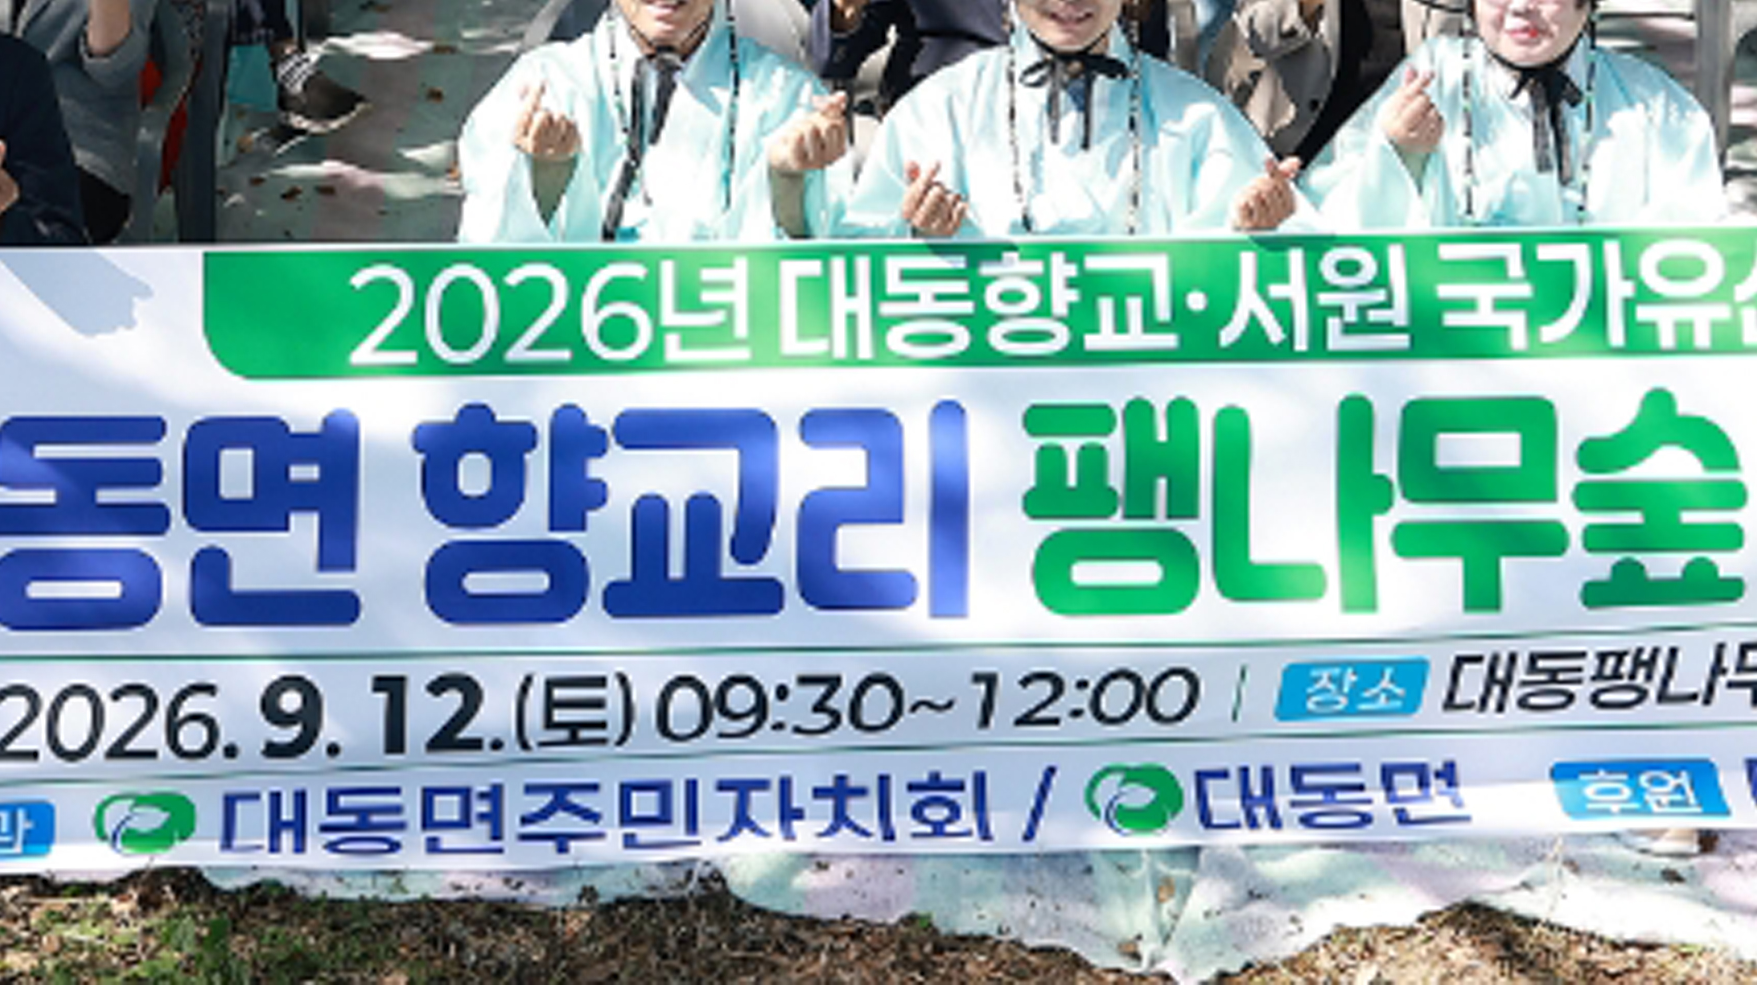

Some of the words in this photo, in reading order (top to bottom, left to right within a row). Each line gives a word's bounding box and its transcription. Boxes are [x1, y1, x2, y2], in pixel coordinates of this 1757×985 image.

[348, 258, 752, 366] 2026년
[777, 243, 1411, 362] 대동향교·서원
[409, 400, 971, 627] 향교리
[1022, 387, 1748, 618] 팽나무숲
[259, 674, 343, 759] 9.
[654, 666, 1203, 744] 09:30~12:00
[1304, 666, 1410, 711] 장소
[216, 770, 994, 855] 대동면주민자치회
[1190, 758, 1475, 832] 대동면
[1578, 762, 1699, 815] 후원
